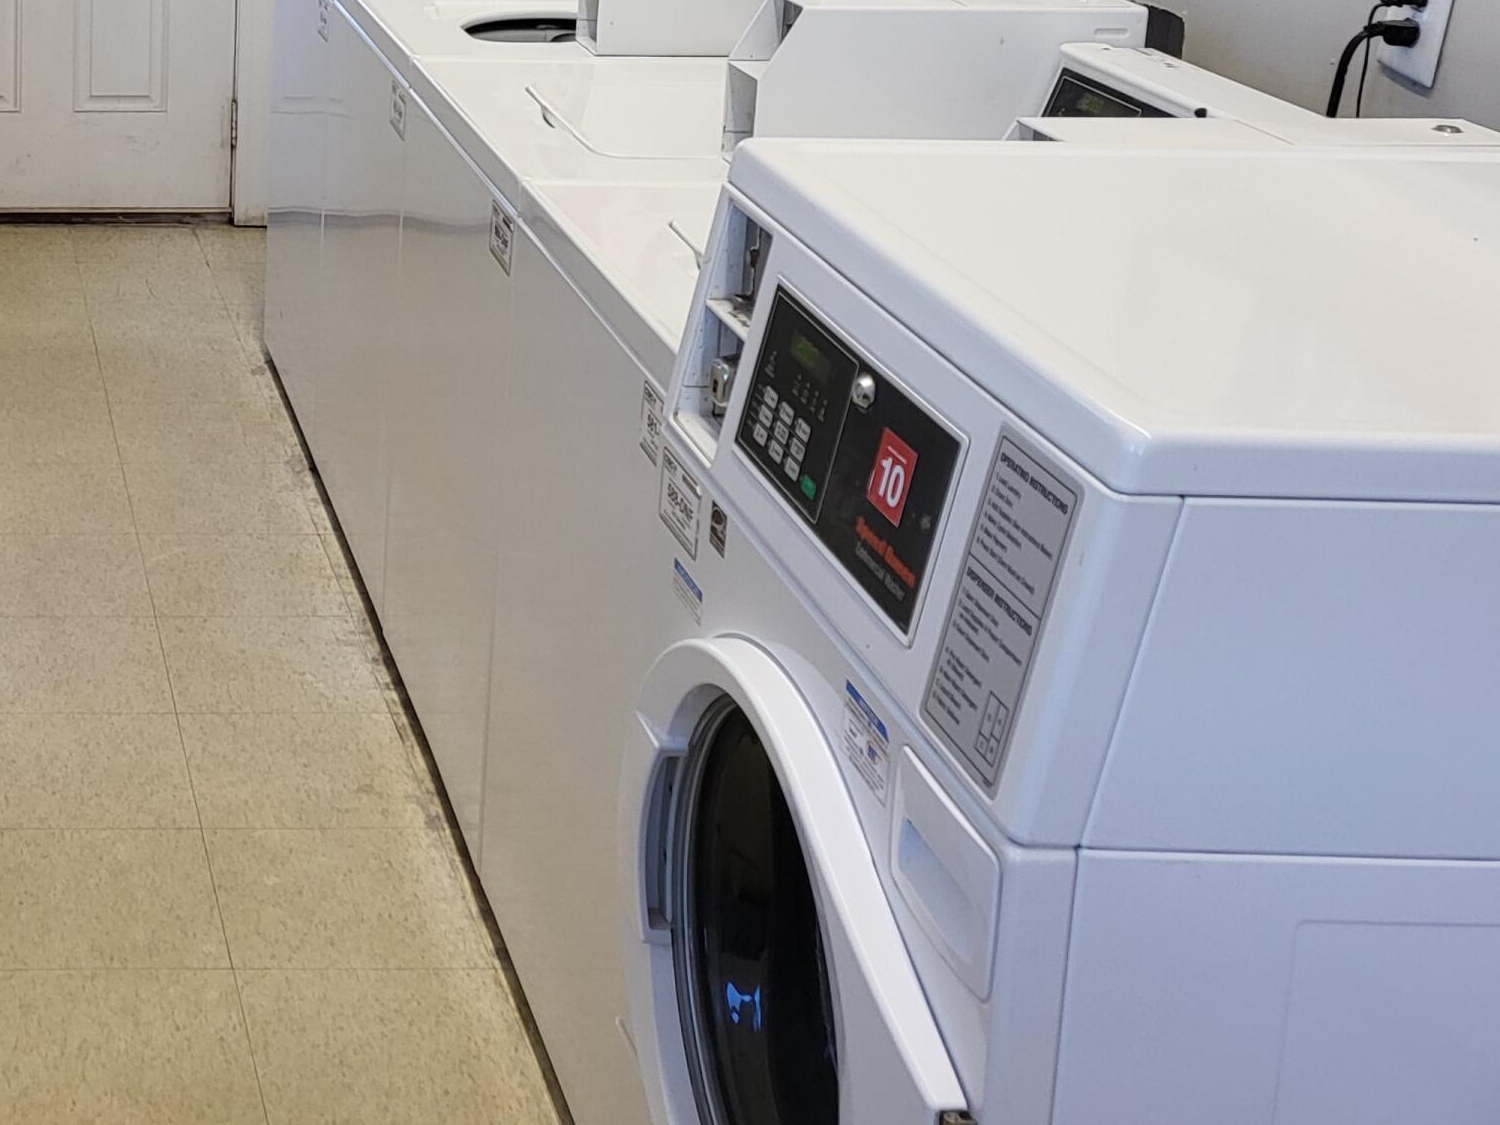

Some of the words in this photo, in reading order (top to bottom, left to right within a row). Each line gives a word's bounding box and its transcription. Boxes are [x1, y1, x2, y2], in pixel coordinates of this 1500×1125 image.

[878, 455, 905, 509] 10
[999, 450, 1030, 484] OPERATING
[1028, 474, 1069, 516] INSTRUCTIONS
[992, 592, 1034, 638] INSTRUCTIONS
